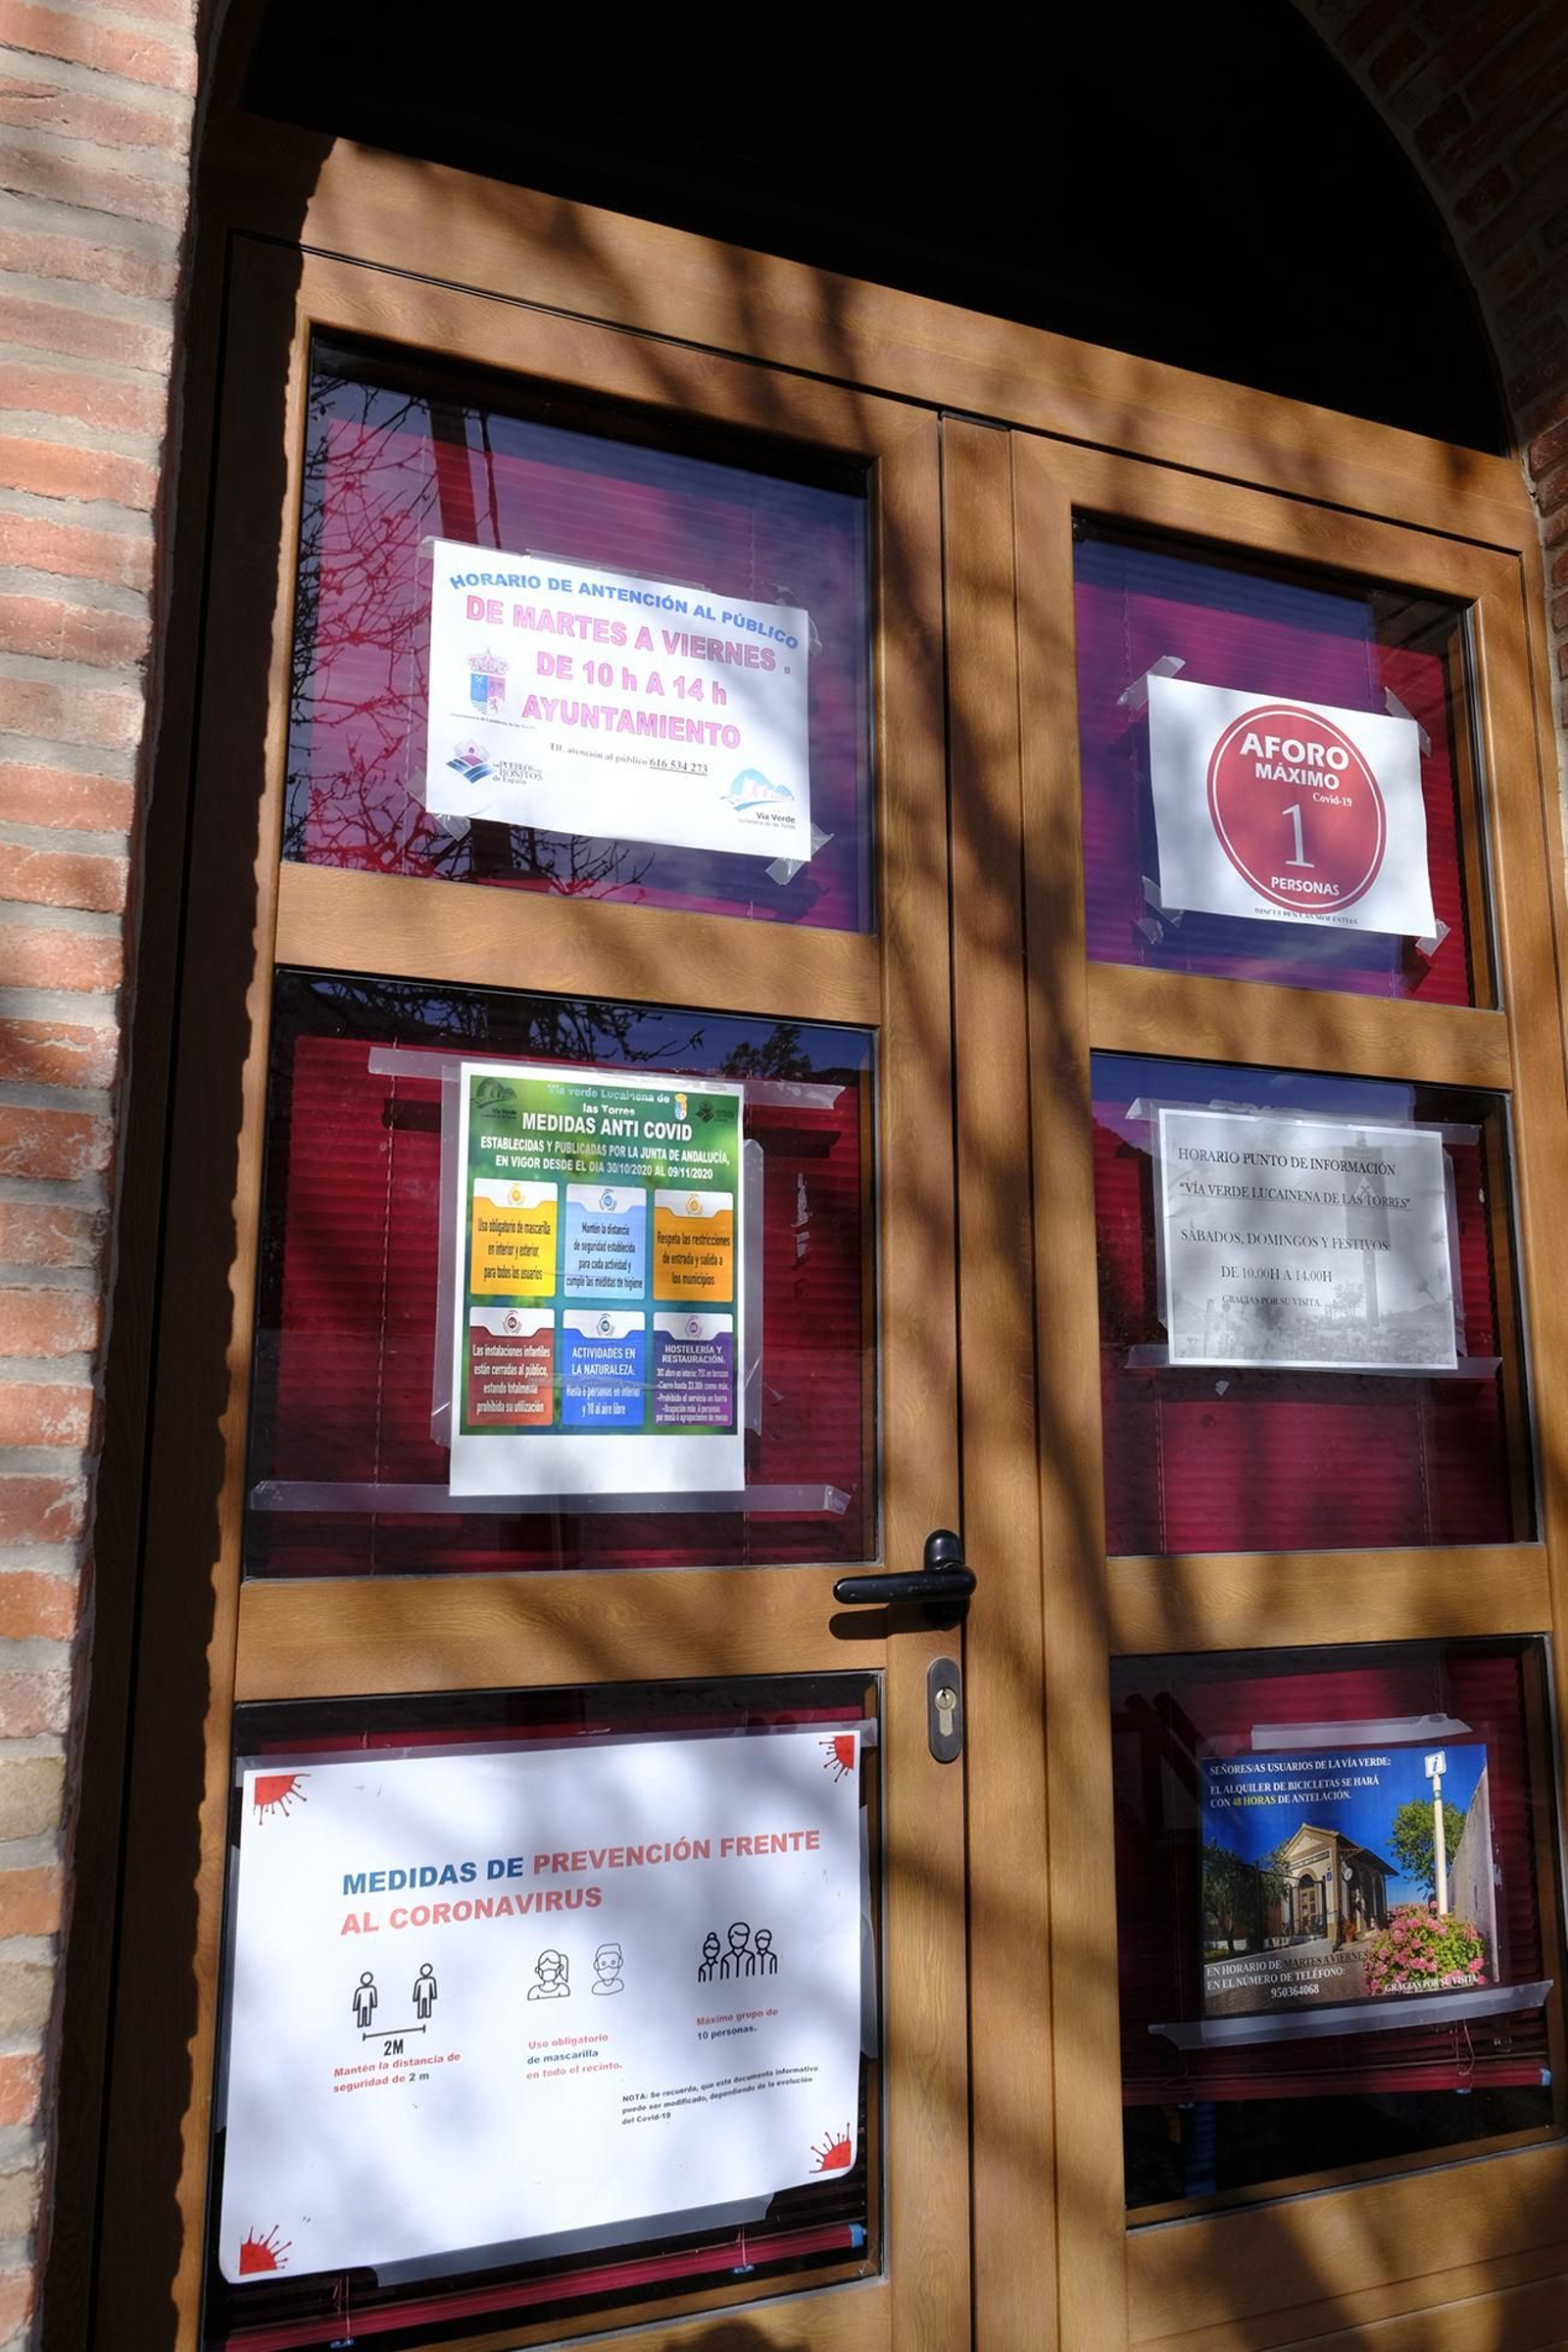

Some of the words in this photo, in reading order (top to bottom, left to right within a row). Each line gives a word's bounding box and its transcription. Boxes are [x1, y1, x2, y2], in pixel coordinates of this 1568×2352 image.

[450, 573, 541, 589] HORARIO
[549, 578, 572, 592] DE
[578, 582, 687, 613] ANTENCIÓN
[694, 606, 715, 620] AL
[722, 612, 798, 649] PÚBLICO
[466, 595, 503, 625] DE
[514, 604, 627, 646] MARTES
[635, 626, 654, 651] A
[662, 629, 775, 671] VIERNES
[537, 651, 572, 680] DE
[583, 661, 613, 687] 10
[622, 667, 637, 691] h
[646, 672, 664, 696] A
[673, 675, 704, 702] 14
[712, 681, 726, 705] h
[521, 694, 741, 749] AYUNTAMIENTO
[1240, 733, 1348, 770] AFORO
[650, 757, 667, 768] 616
[670, 760, 687, 771] 534
[1255, 762, 1339, 790] MÁXIMO
[1313, 793, 1351, 807] Covid-19
[1282, 804, 1315, 868] 1
[1271, 877, 1340, 896] PERSONAS
[583, 1102, 598, 1113] las
[602, 1104, 635, 1115] Torres
[523, 1112, 596, 1134] MEDIDAS
[601, 1119, 638, 1137] ANTI
[644, 1121, 692, 1141] COVID
[481, 1136, 544, 1152] ESTABLECIDAS
[547, 1141, 552, 1152] Y
[555, 1141, 607, 1156] PUBLICADAS
[610, 1145, 626, 1157] POR
[628, 1147, 638, 1158] LA
[640, 1148, 666, 1160] JUNTA
[669, 1150, 679, 1161] DE
[496, 1155, 508, 1166] EN
[512, 1156, 540, 1169] VIGOR
[543, 1158, 573, 1170] DESDE
[575, 1160, 586, 1171] EL
[655, 1165, 665, 1176] AL
[1178, 1148, 1239, 1164] HORARIO
[1244, 1152, 1287, 1167] PUNTO
[1292, 1156, 1307, 1169] DE
[1311, 1158, 1396, 1175] INFORMACIÓN
[1208, 1185, 1250, 1197] VERDE
[1252, 1187, 1320, 1202] LUCAINENA
[1324, 1192, 1340, 1203] DE
[1343, 1194, 1362, 1204] LAS
[517, 1219, 523, 1233] de
[658, 1232, 680, 1248] Respeta
[692, 1235, 730, 1247] restricciones
[1248, 1233, 1319, 1248] DOMINGOS
[1322, 1237, 1328, 1248] Y
[662, 1252, 669, 1264] de
[671, 1253, 694, 1265] entrada
[695, 1256, 699, 1267] y
[701, 1253, 717, 1265] salida
[672, 1272, 681, 1284] los
[1222, 1265, 1239, 1278] DE
[1284, 1270, 1292, 1280] A
[472, 1345, 483, 1356] Las
[572, 1348, 622, 1358] ACTIVIDADES
[625, 1348, 635, 1358] EN
[665, 1345, 713, 1353] HOSTELERÍA
[571, 1364, 581, 1375] LA
[1210, 1764, 1265, 1775] SEÑORES/AS
[1268, 1762, 1313, 1772] USUARIOS
[1315, 1761, 1327, 1770] DE
[1342, 1757, 1358, 1768] VÍA
[1210, 1786, 1222, 1794] EL
[1224, 1783, 1271, 1794] ALQUILER
[1274, 1783, 1286, 1791] DE
[1288, 1779, 1340, 1790] BICICLETAS
[1342, 1778, 1351, 1787] SE
[1353, 1776, 1379, 1786] HARÁ
[1210, 1798, 1230, 1808] CON
[1244, 1795, 1275, 1805] HORAS
[1278, 1794, 1290, 1803] DE
[343, 1862, 477, 1895] MEDIDAS
[487, 1857, 523, 1880] DE
[533, 1837, 710, 1875] PREVENCIÓN
[721, 1831, 819, 1858] FRENTE
[340, 1912, 379, 1935] AL
[390, 1886, 602, 1930] CORONAVIRUS
[1207, 1967, 1220, 1977] EN
[1222, 1962, 1266, 1975] HORARIO
[1269, 1960, 1282, 1969] DE
[1207, 1982, 1220, 1990] EN
[1222, 1980, 1235, 1988] EL
[1236, 1975, 1278, 1986] NÚMERO
[1280, 1973, 1293, 1982] DE
[1385, 1982, 1421, 1991] GRACIAS
[697, 2015, 733, 2027] Máximo
[736, 2011, 763, 2022] grupo
[529, 2040, 549, 2049] Uso
[552, 2034, 609, 2046] obligatorio
[698, 2032, 709, 2040] 10
[711, 2026, 757, 2039] personas.
[384, 2039, 404, 2056] 2M
[334, 2064, 375, 2078] Mantén
[393, 2055, 444, 2068] distancia
[447, 2053, 461, 2062] de
[527, 2056, 539, 2065] de
[544, 2049, 598, 2062] mascarilla
[543, 2068, 565, 2077] todo
[582, 2063, 622, 2073] recinto.
[733, 2071, 773, 2082] documento
[775, 2066, 817, 2075] informativo
[333, 2077, 389, 2092] seguridad
[392, 2075, 406, 2083] de
[409, 2073, 416, 2082] 2
[622, 2104, 647, 2115] puede
[710, 2085, 755, 2100] dependiendo
[637, 2112, 670, 2123] Covid-19
